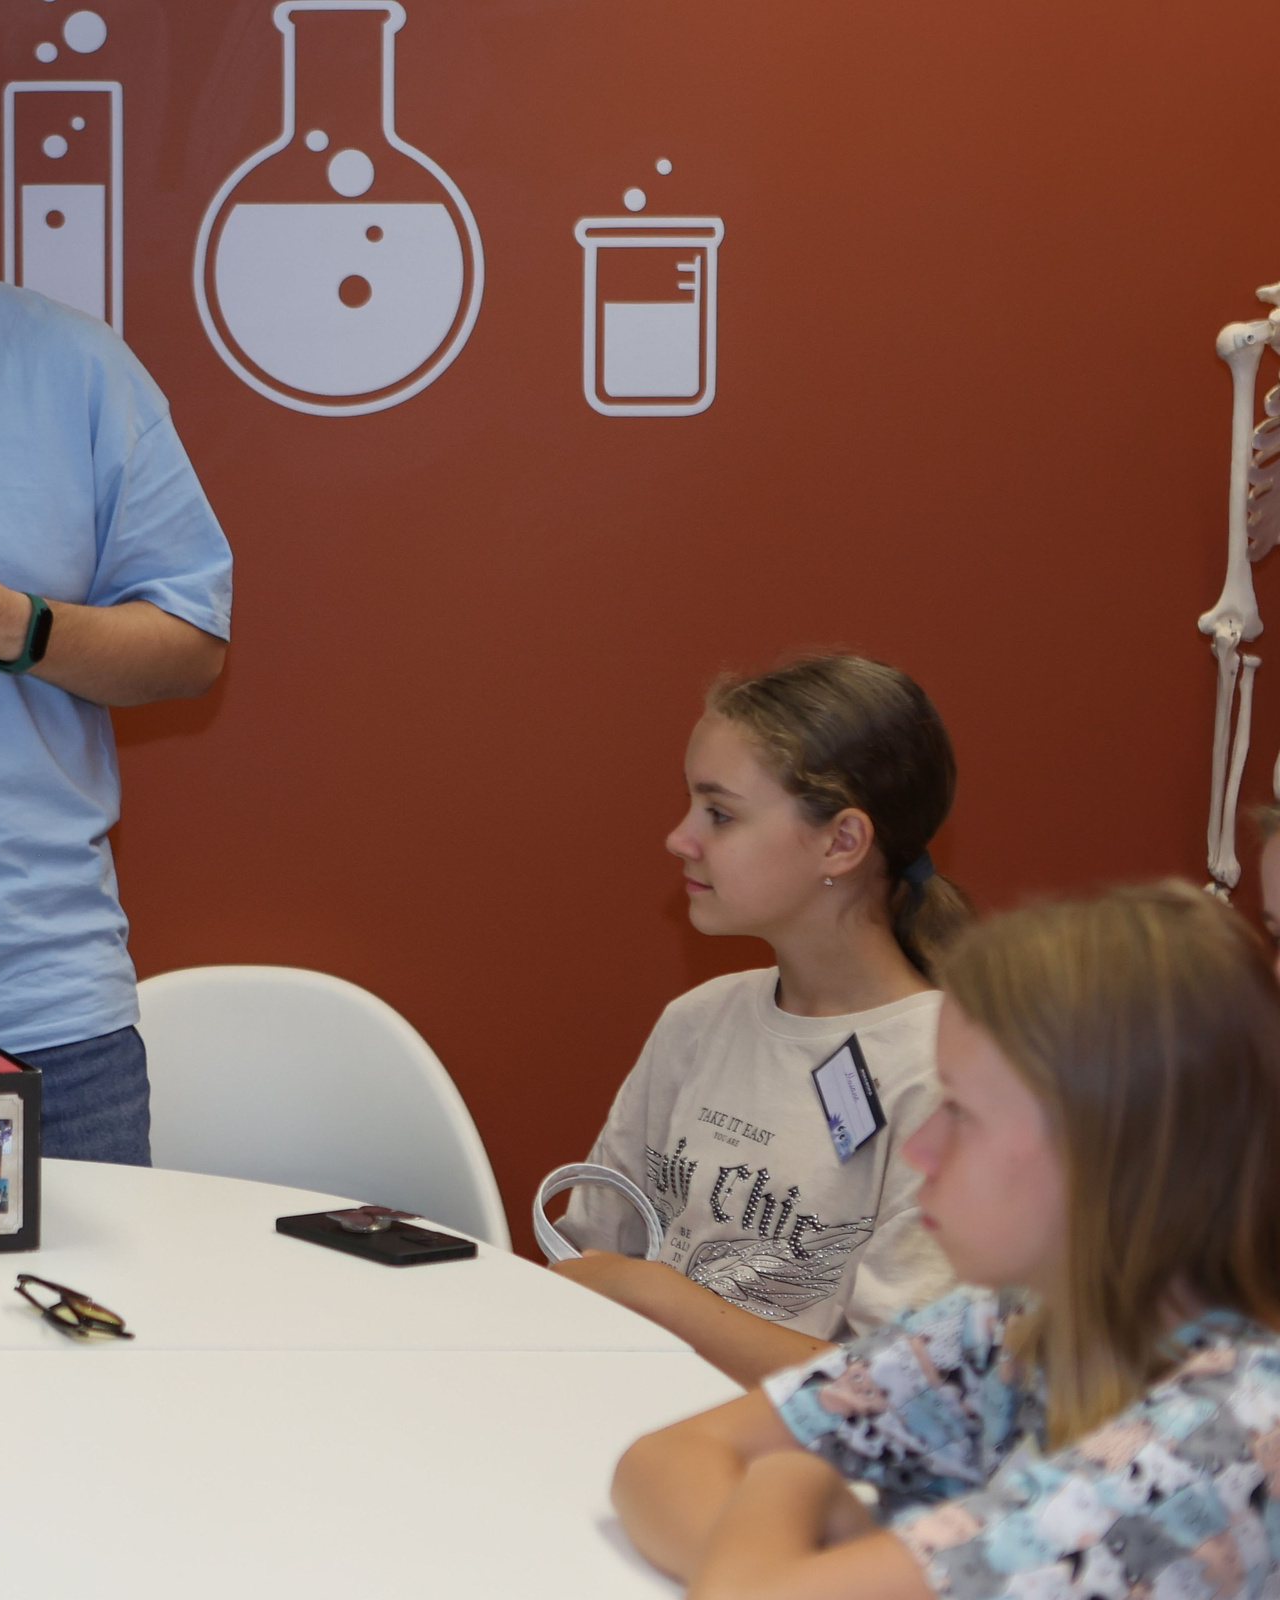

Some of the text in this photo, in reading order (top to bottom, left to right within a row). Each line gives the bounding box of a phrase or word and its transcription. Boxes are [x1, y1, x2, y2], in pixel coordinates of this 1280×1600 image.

[697, 1107, 776, 1146] TAKE IT EASY
[713, 1131, 741, 1147] YOU ARE
[710, 1163, 830, 1261] Chic
[680, 1226, 692, 1239] BE
